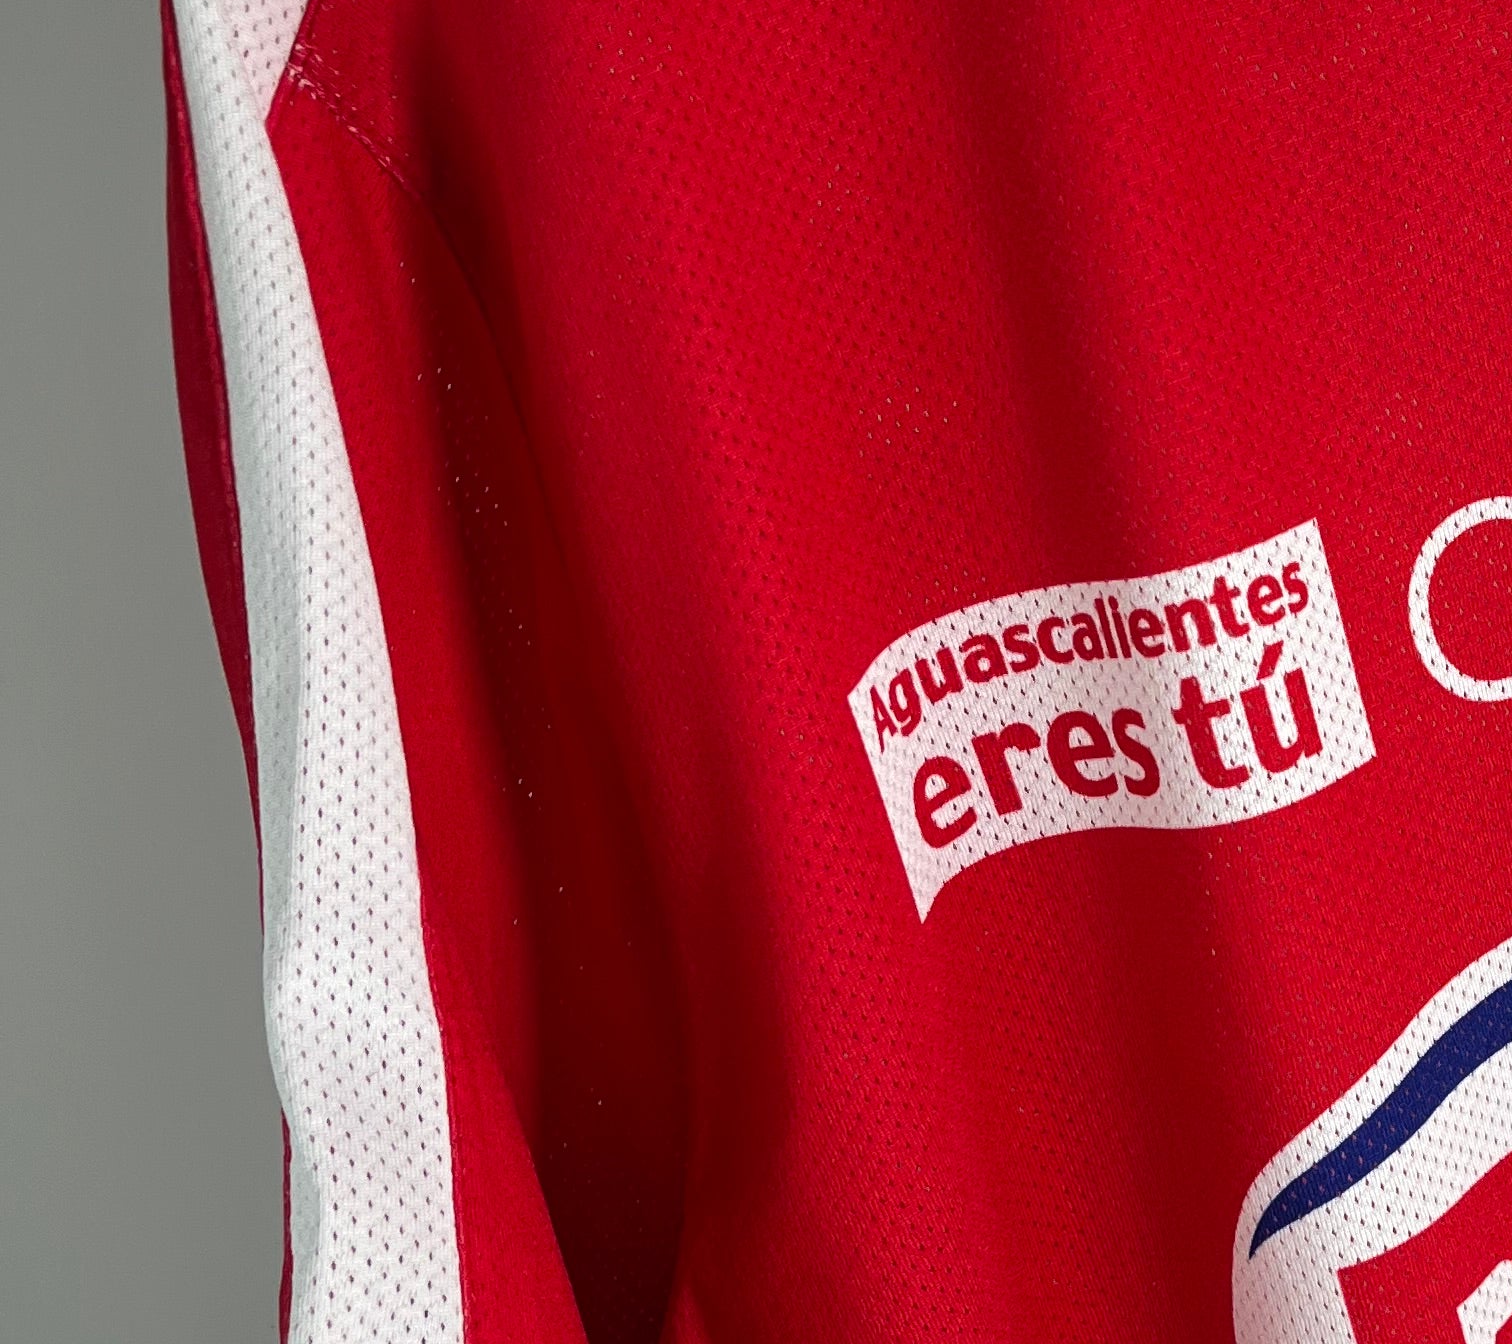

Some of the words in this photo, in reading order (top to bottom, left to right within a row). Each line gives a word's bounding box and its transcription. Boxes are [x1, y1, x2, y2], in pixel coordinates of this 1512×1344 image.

[868, 561, 1310, 754] Aguascalientes
[911, 707, 1161, 851] eres
[1171, 641, 1325, 790] tú
